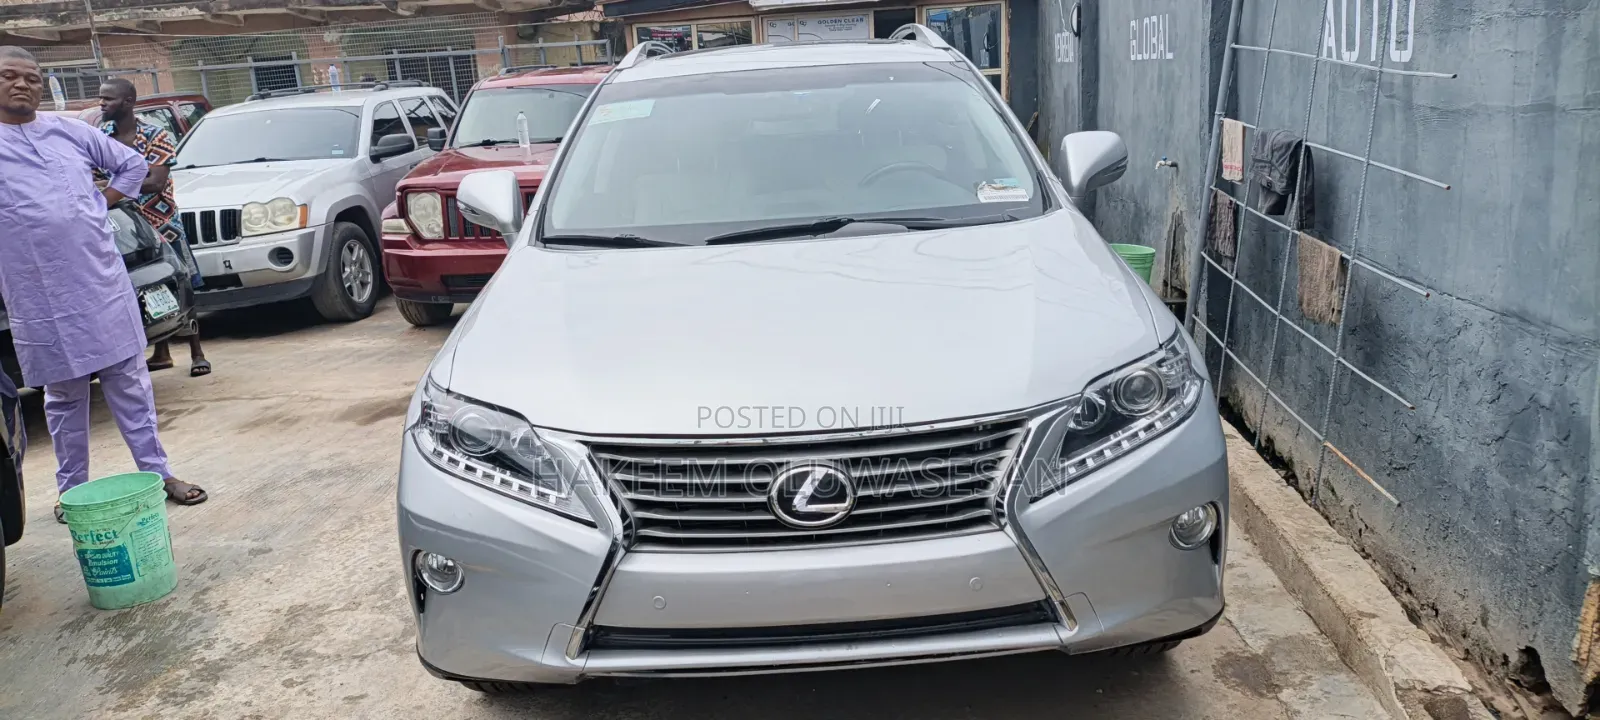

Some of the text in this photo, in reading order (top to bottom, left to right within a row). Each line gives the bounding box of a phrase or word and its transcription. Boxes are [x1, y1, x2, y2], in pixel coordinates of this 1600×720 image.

[1129, 14, 1174, 61] GLOBAL
[70, 528, 120, 546] Perfect
[88, 558, 119, 567] Emulsion
